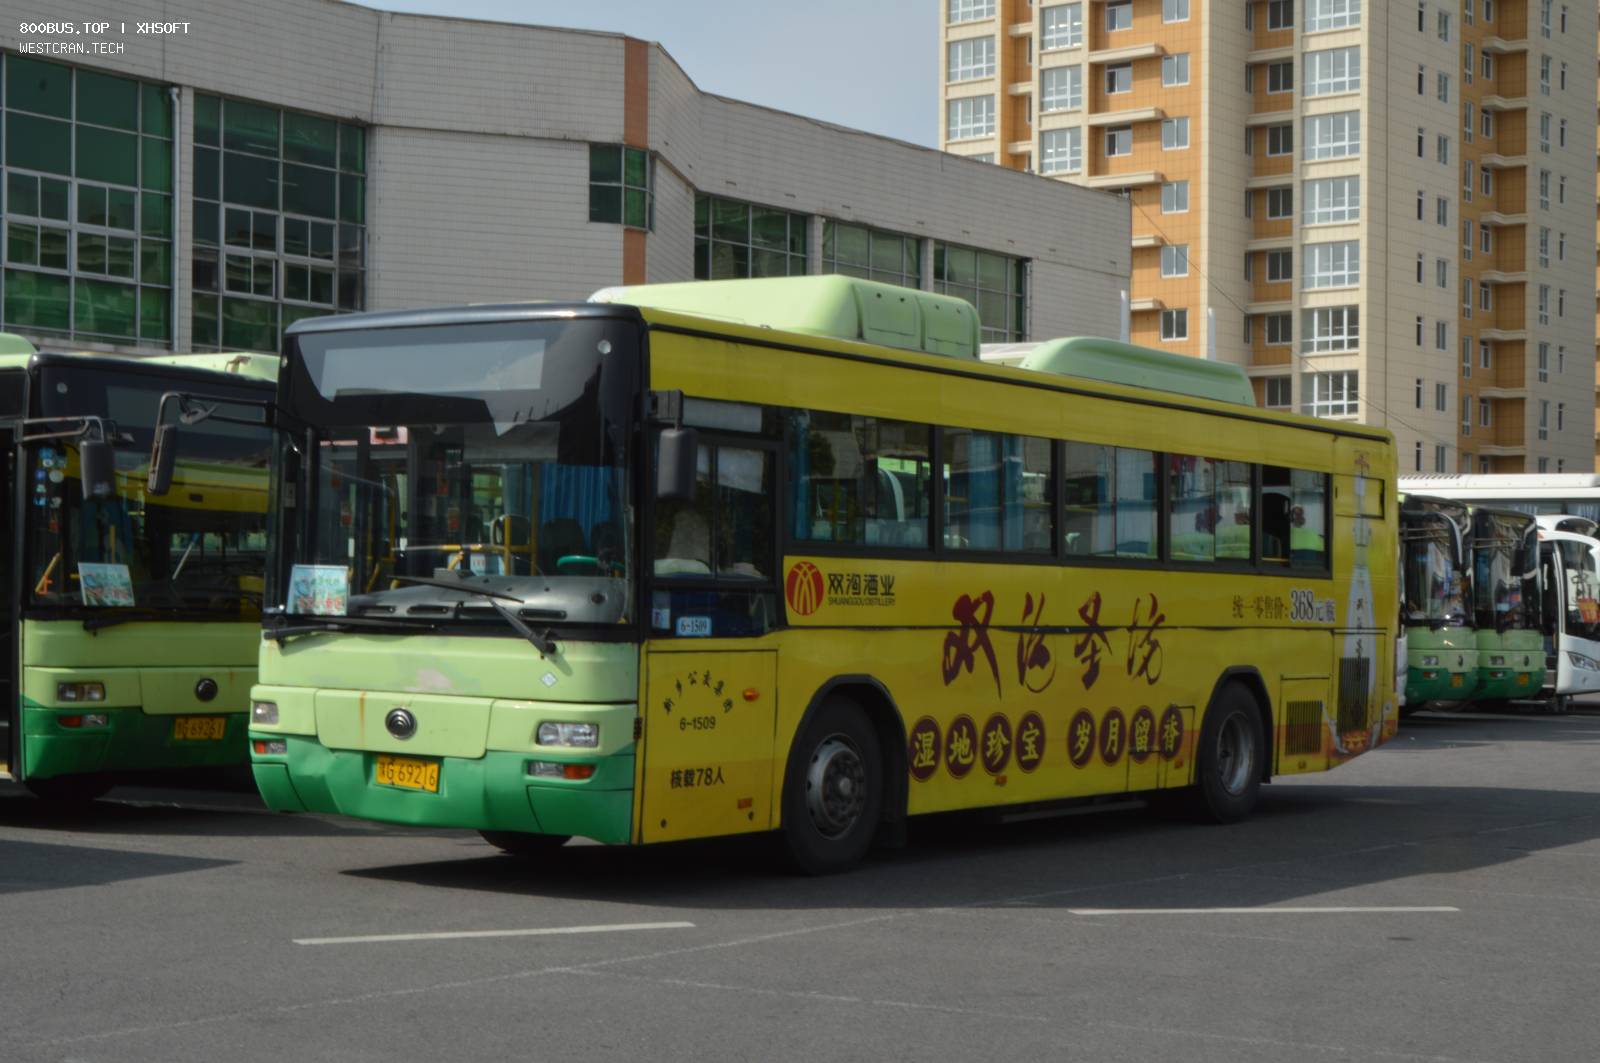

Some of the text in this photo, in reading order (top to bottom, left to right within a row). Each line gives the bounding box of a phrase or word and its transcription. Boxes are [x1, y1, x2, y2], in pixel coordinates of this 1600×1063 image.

[827, 573, 896, 596] 双沟酒业
[680, 619, 708, 633] 6-1509
[679, 716, 717, 731] 6-1509
[912, 711, 1181, 770] 湿地珍宝 岁月留香
[670, 765, 726, 789] 核载78人
